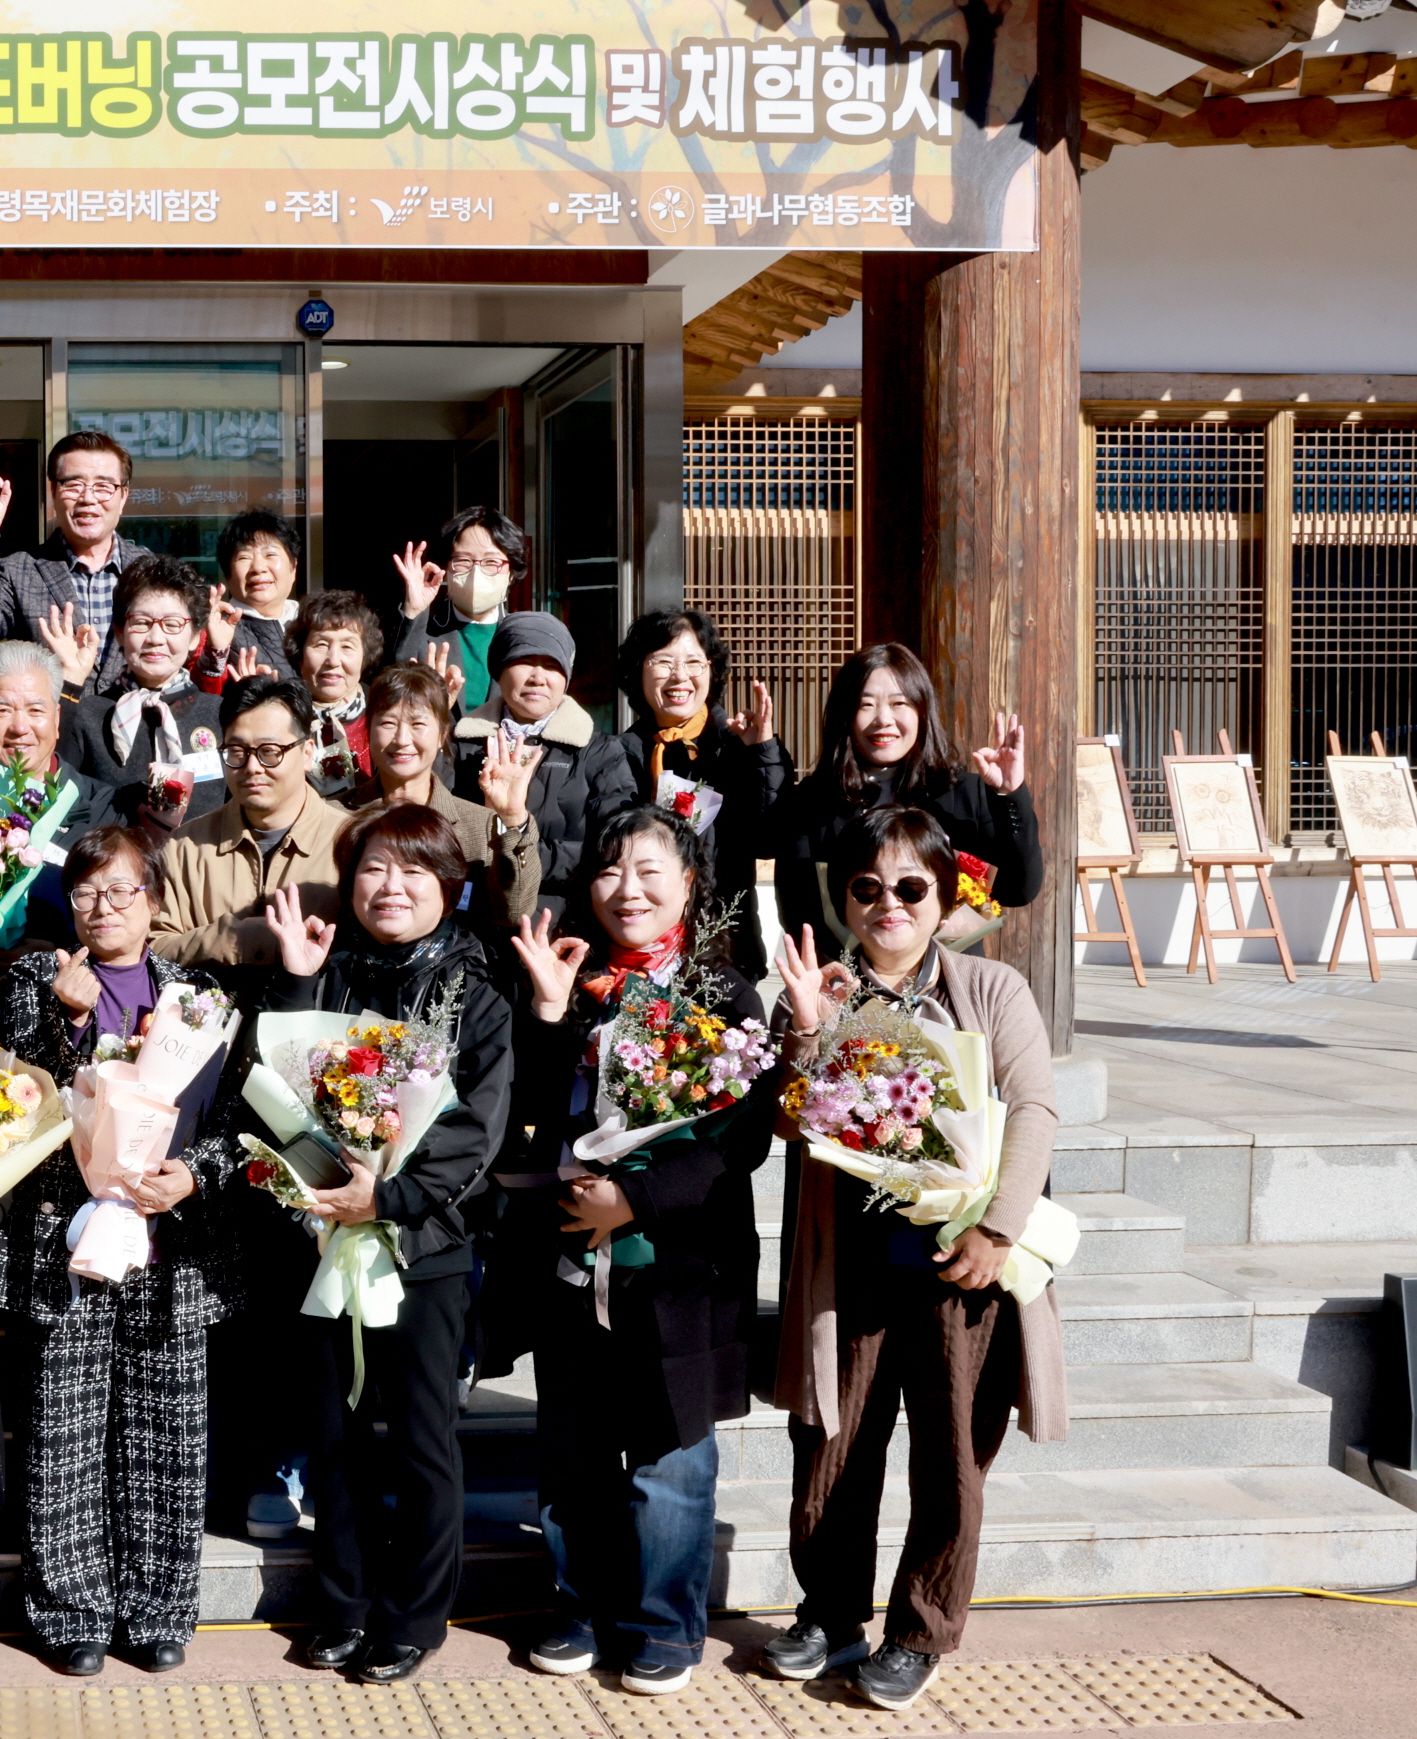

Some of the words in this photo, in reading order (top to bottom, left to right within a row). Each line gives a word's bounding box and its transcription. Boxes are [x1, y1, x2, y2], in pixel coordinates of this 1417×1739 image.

[173, 39, 587, 133] 공모전시상식
[610, 52, 661, 125] 및
[679, 44, 960, 137] 체험행사
[283, 190, 340, 223] 주최
[428, 197, 494, 222] 보령시
[566, 191, 622, 225] 주관
[701, 193, 915, 227] 글과나무협동조합
[305, 311, 329, 324] ADT
[153, 1034, 192, 1061] JOIE
